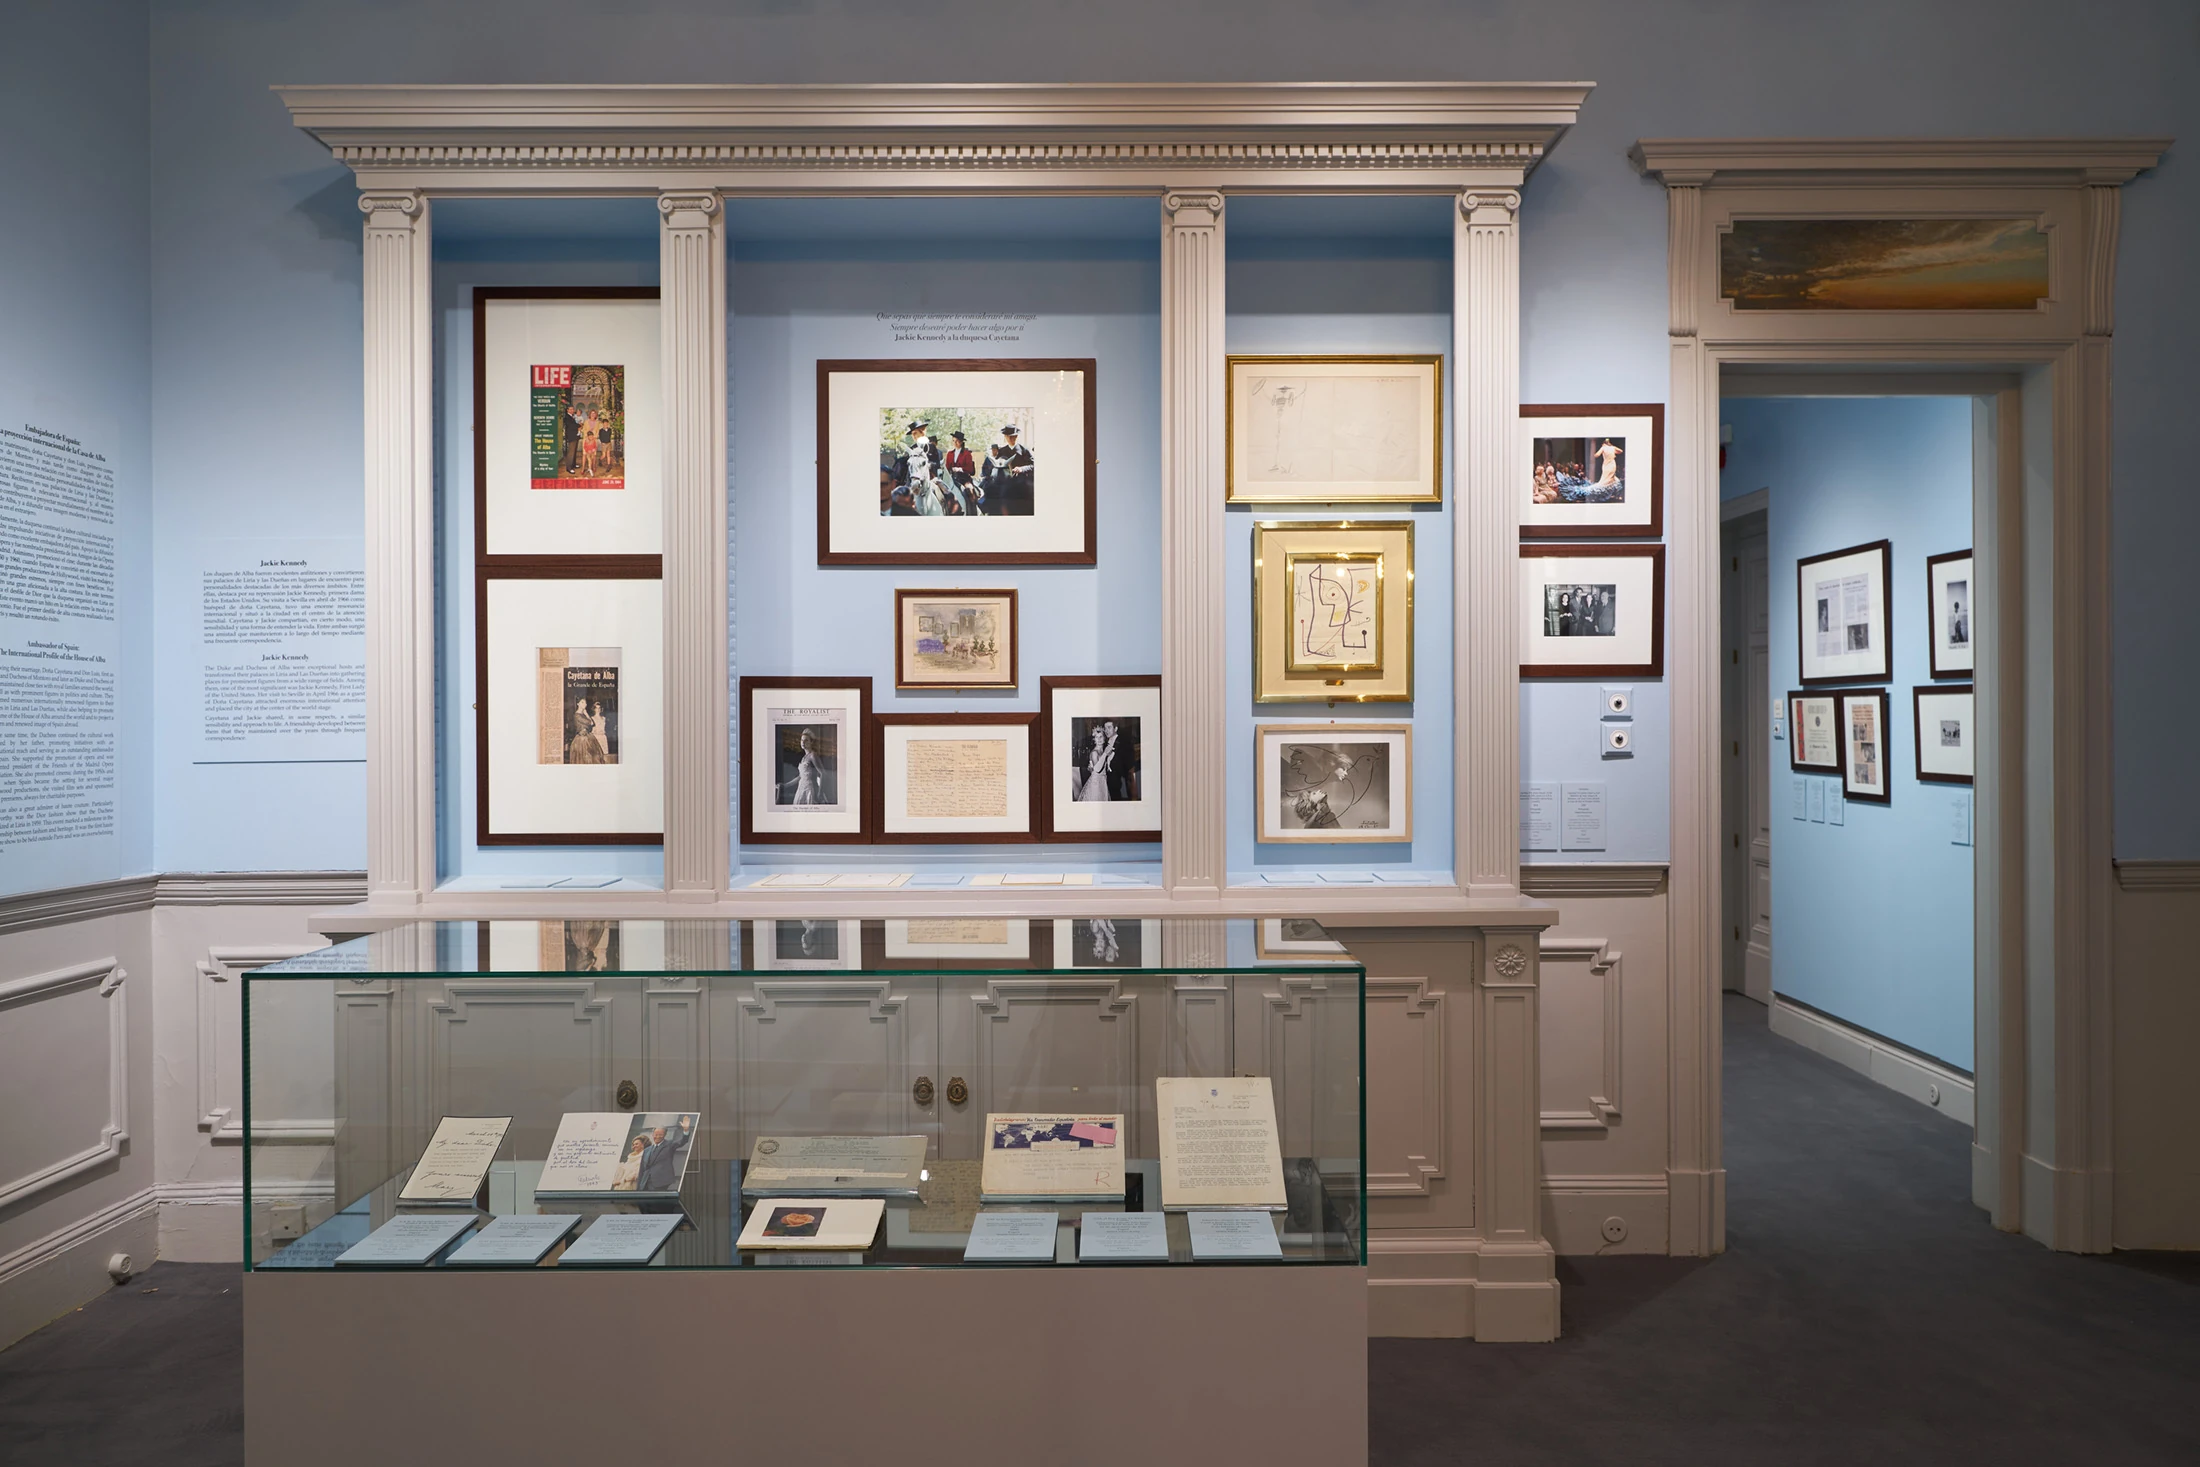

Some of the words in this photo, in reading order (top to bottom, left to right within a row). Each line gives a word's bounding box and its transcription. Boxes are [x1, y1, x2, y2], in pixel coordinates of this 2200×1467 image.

[535, 367, 569, 384] LIFE
[25, 424, 55, 438] Embajadora
[4, 429, 32, 442] proyección
[33, 436, 65, 451] internacional
[78, 449, 88, 457] Casa
[95, 453, 105, 462] Alba
[8, 649, 42, 658] International
[568, 671, 591, 681] Cayetana
